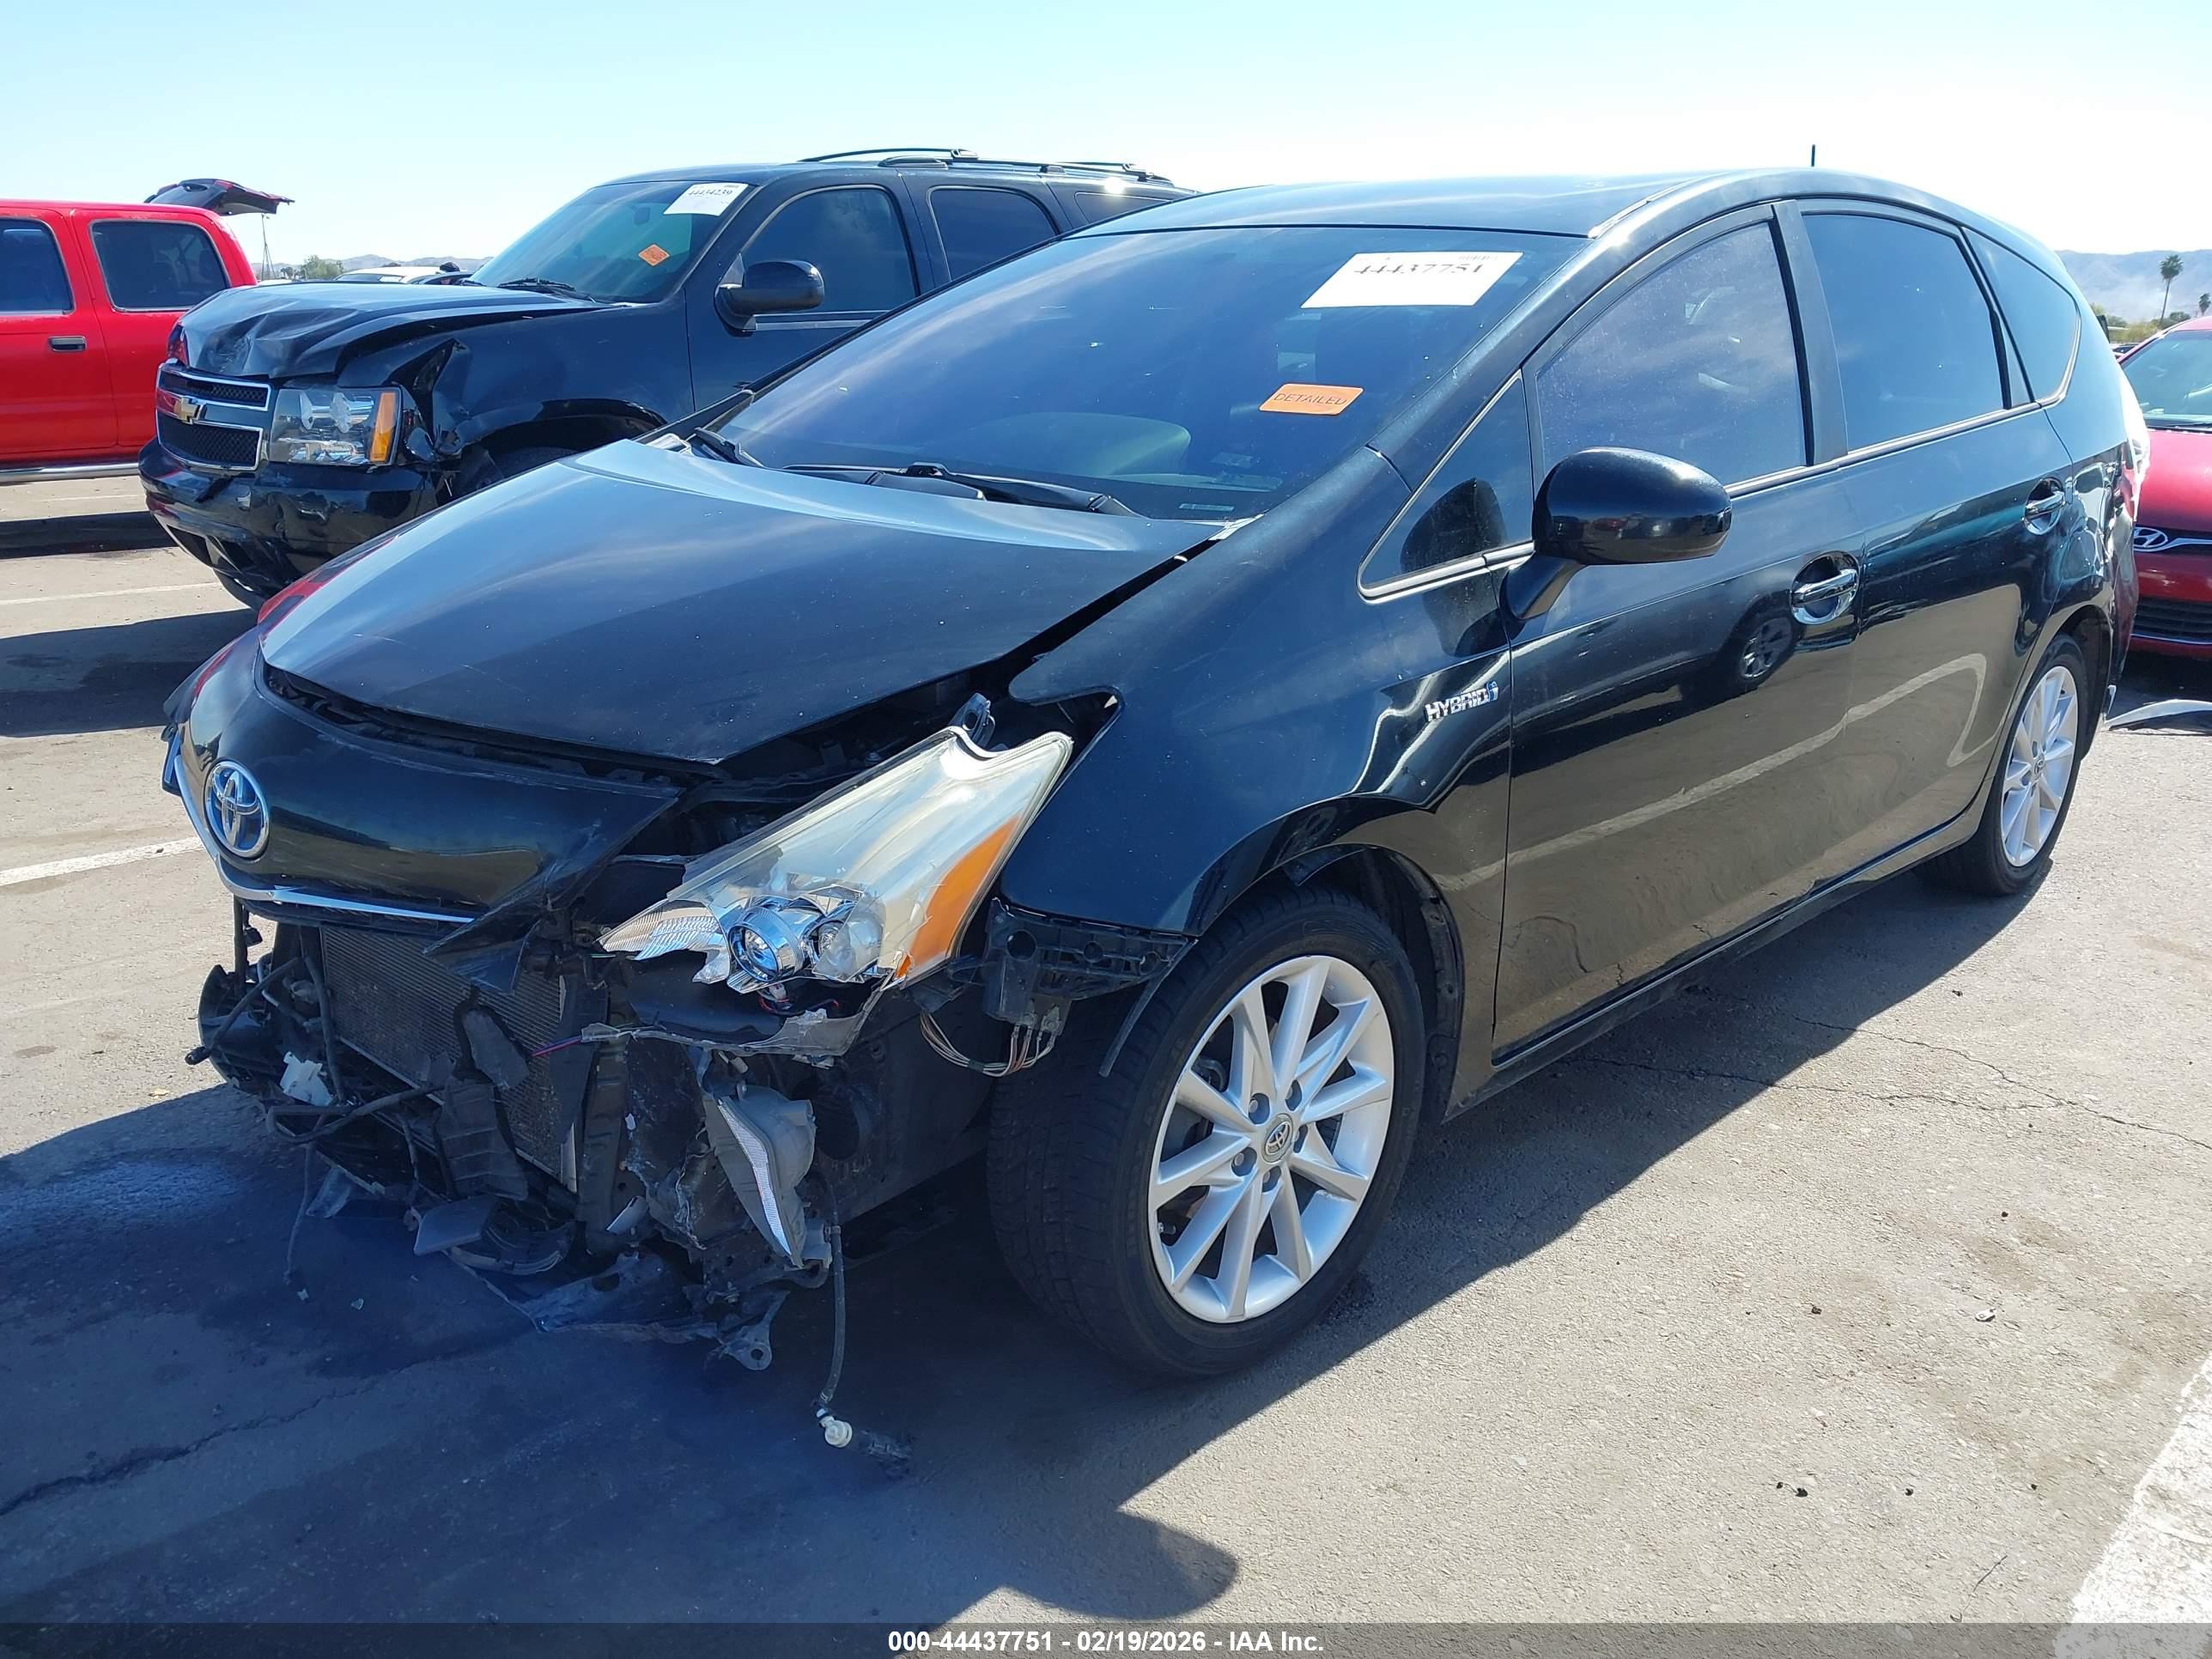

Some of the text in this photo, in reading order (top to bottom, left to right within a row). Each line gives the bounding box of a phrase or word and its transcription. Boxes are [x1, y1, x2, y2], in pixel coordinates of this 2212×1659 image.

[1352, 264, 1484, 274] 44437751
[1273, 392, 1347, 405] DETAILED
[1425, 688, 1491, 722] HYBRID
